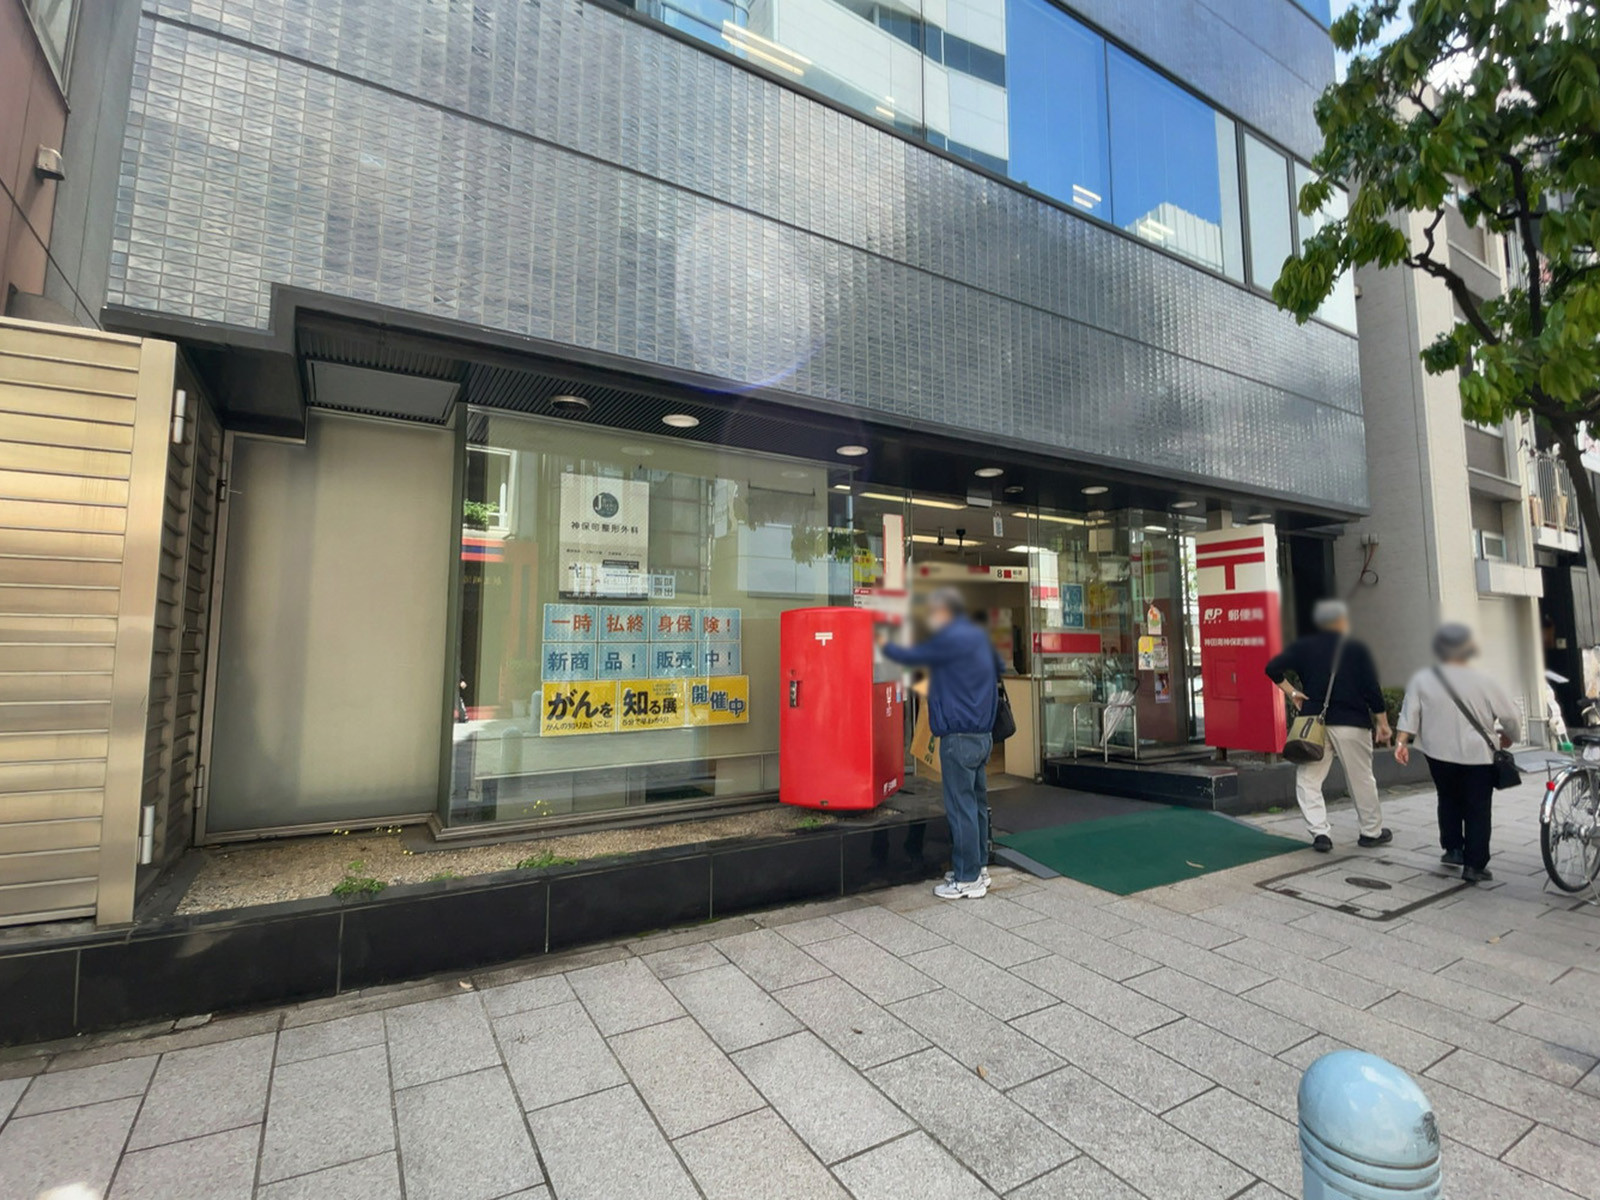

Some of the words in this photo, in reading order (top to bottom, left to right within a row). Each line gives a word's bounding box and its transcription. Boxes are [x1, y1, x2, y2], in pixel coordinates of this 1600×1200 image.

[571, 521, 639, 534] 神保町整形外科
[996, 569, 1003, 579] 8
[691, 685, 745, 718] 開催中
